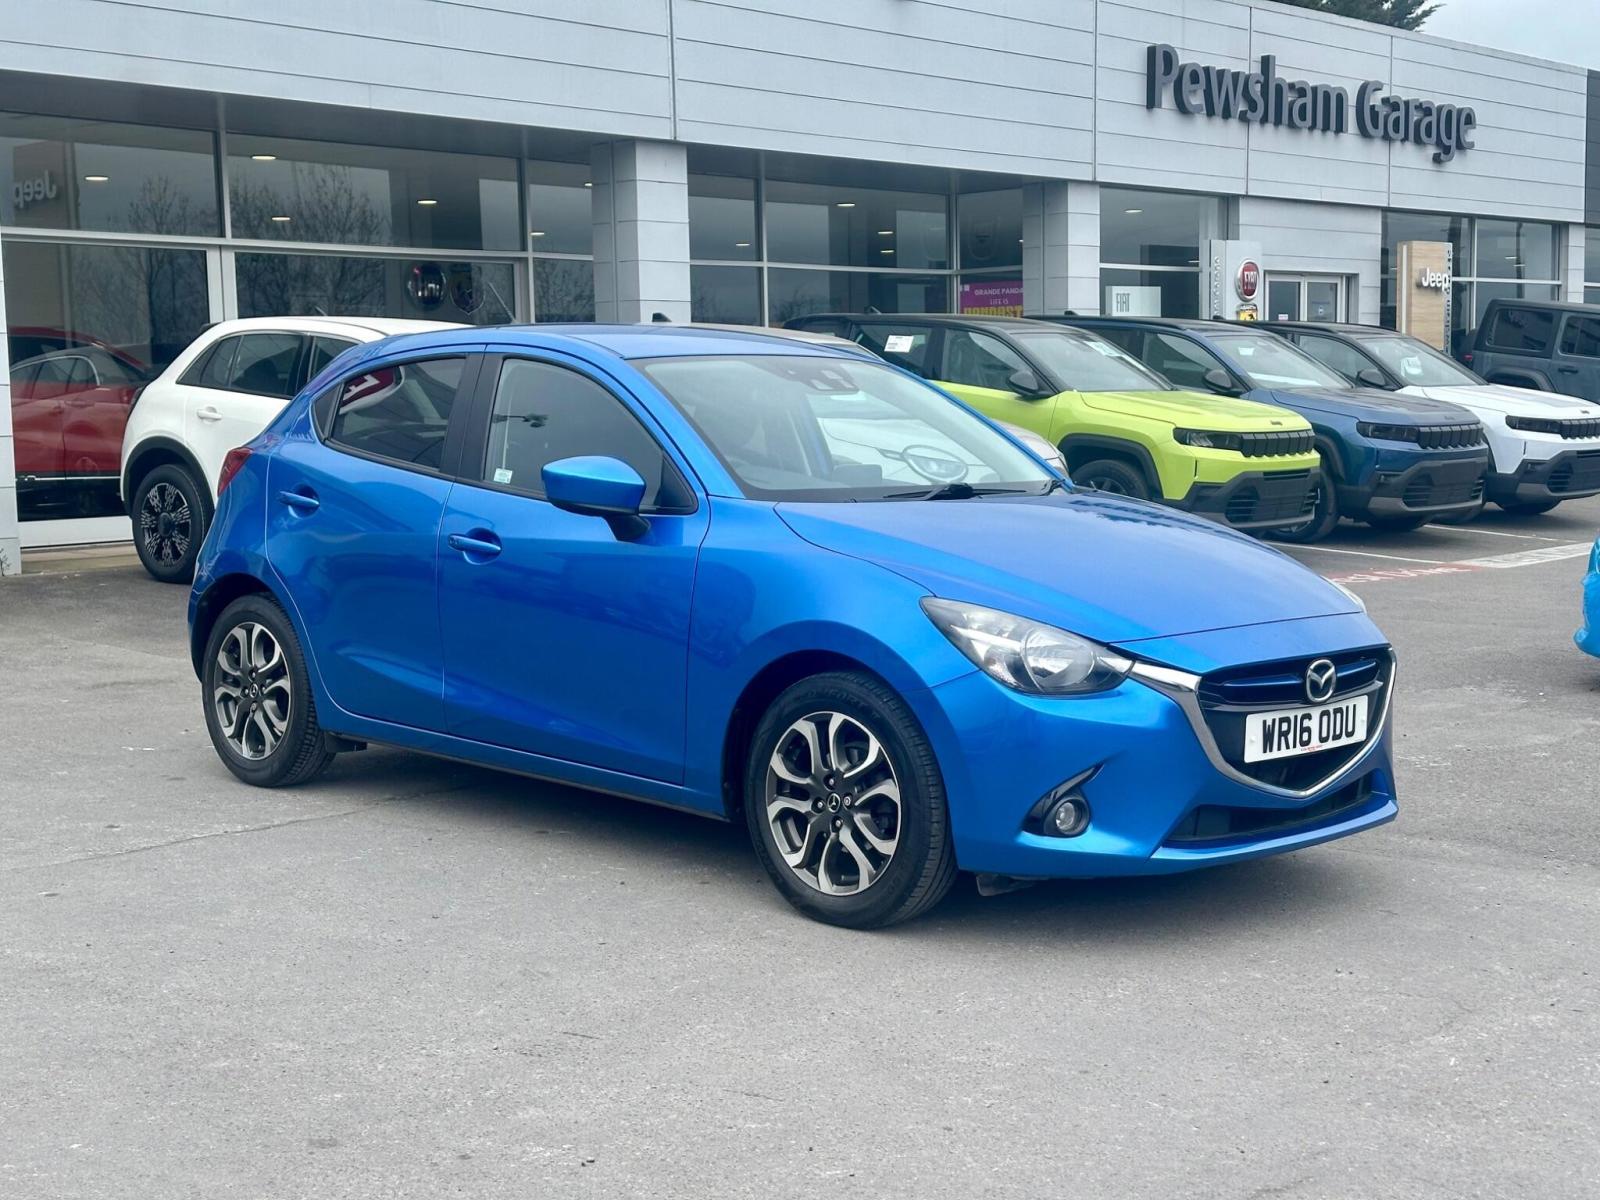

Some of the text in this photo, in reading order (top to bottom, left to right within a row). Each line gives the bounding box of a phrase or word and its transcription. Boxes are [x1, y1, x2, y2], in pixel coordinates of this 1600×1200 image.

[1146, 43, 1477, 164] Pewsham Garage
[1421, 267, 1449, 292] Jeep
[1116, 293, 1130, 312] FIAT
[1262, 703, 1357, 754] WR16 ODU
